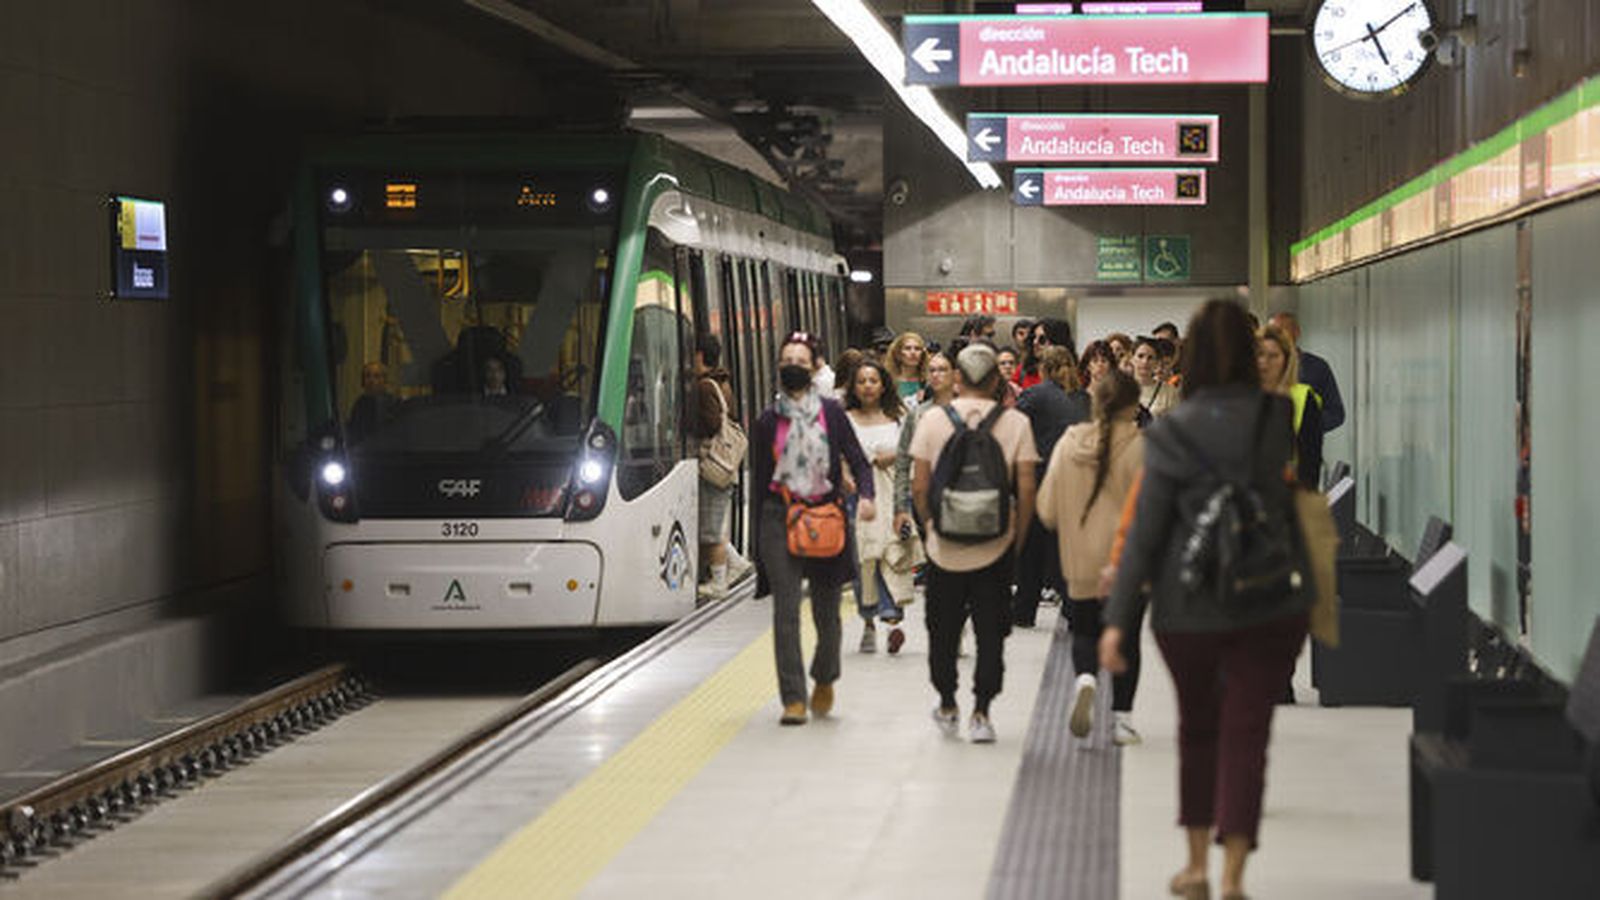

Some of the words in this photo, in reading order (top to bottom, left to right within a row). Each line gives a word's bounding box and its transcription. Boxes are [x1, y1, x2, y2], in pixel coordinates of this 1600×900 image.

[979, 26, 1045, 43] dirección
[979, 45, 1116, 77] Andalucía
[1125, 46, 1189, 75] Tech
[1019, 136, 1114, 156] Andalucía
[1121, 136, 1165, 155] Tech
[1132, 184, 1165, 201] Tech
[441, 522, 479, 538] 3120
